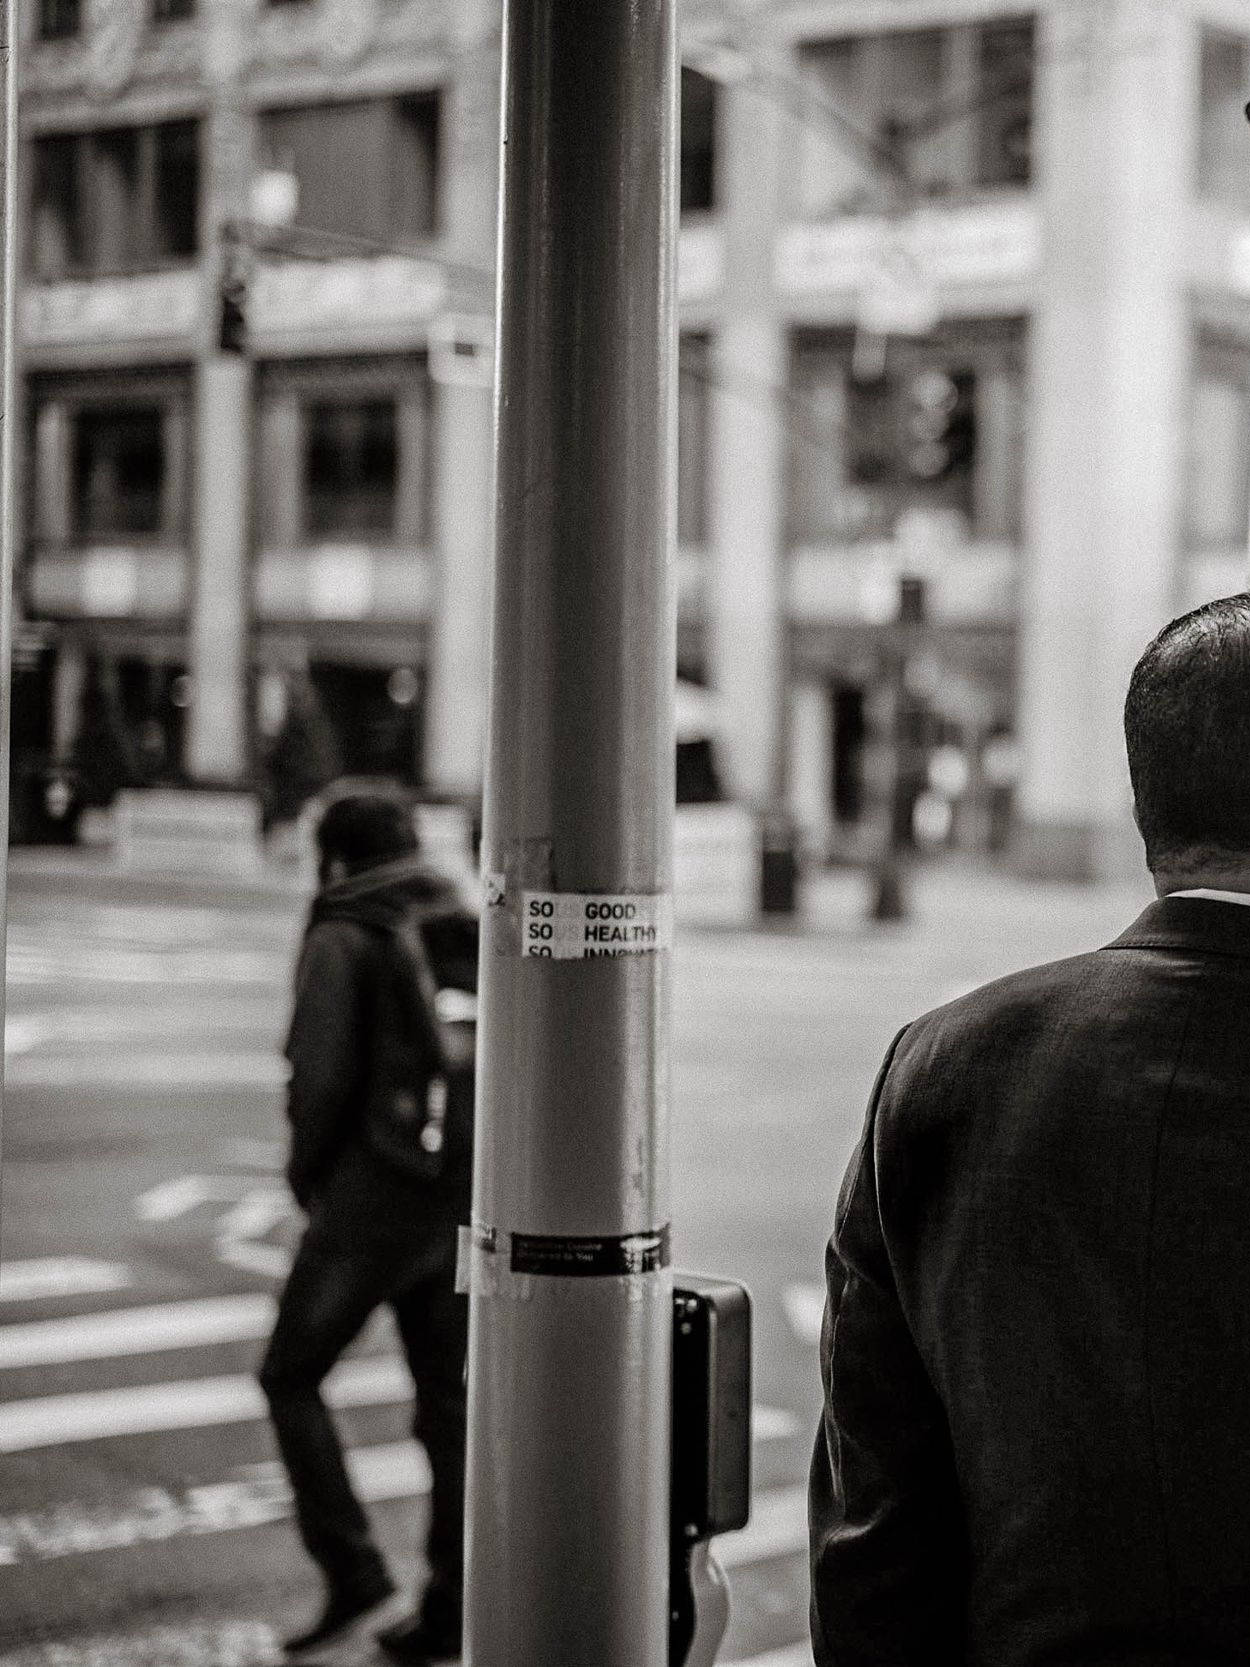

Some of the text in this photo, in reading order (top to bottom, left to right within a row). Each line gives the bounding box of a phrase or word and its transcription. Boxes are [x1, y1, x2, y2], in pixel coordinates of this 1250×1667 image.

[530, 901, 554, 918] SO
[585, 902, 636, 919] GOOD
[529, 923, 553, 940] SO
